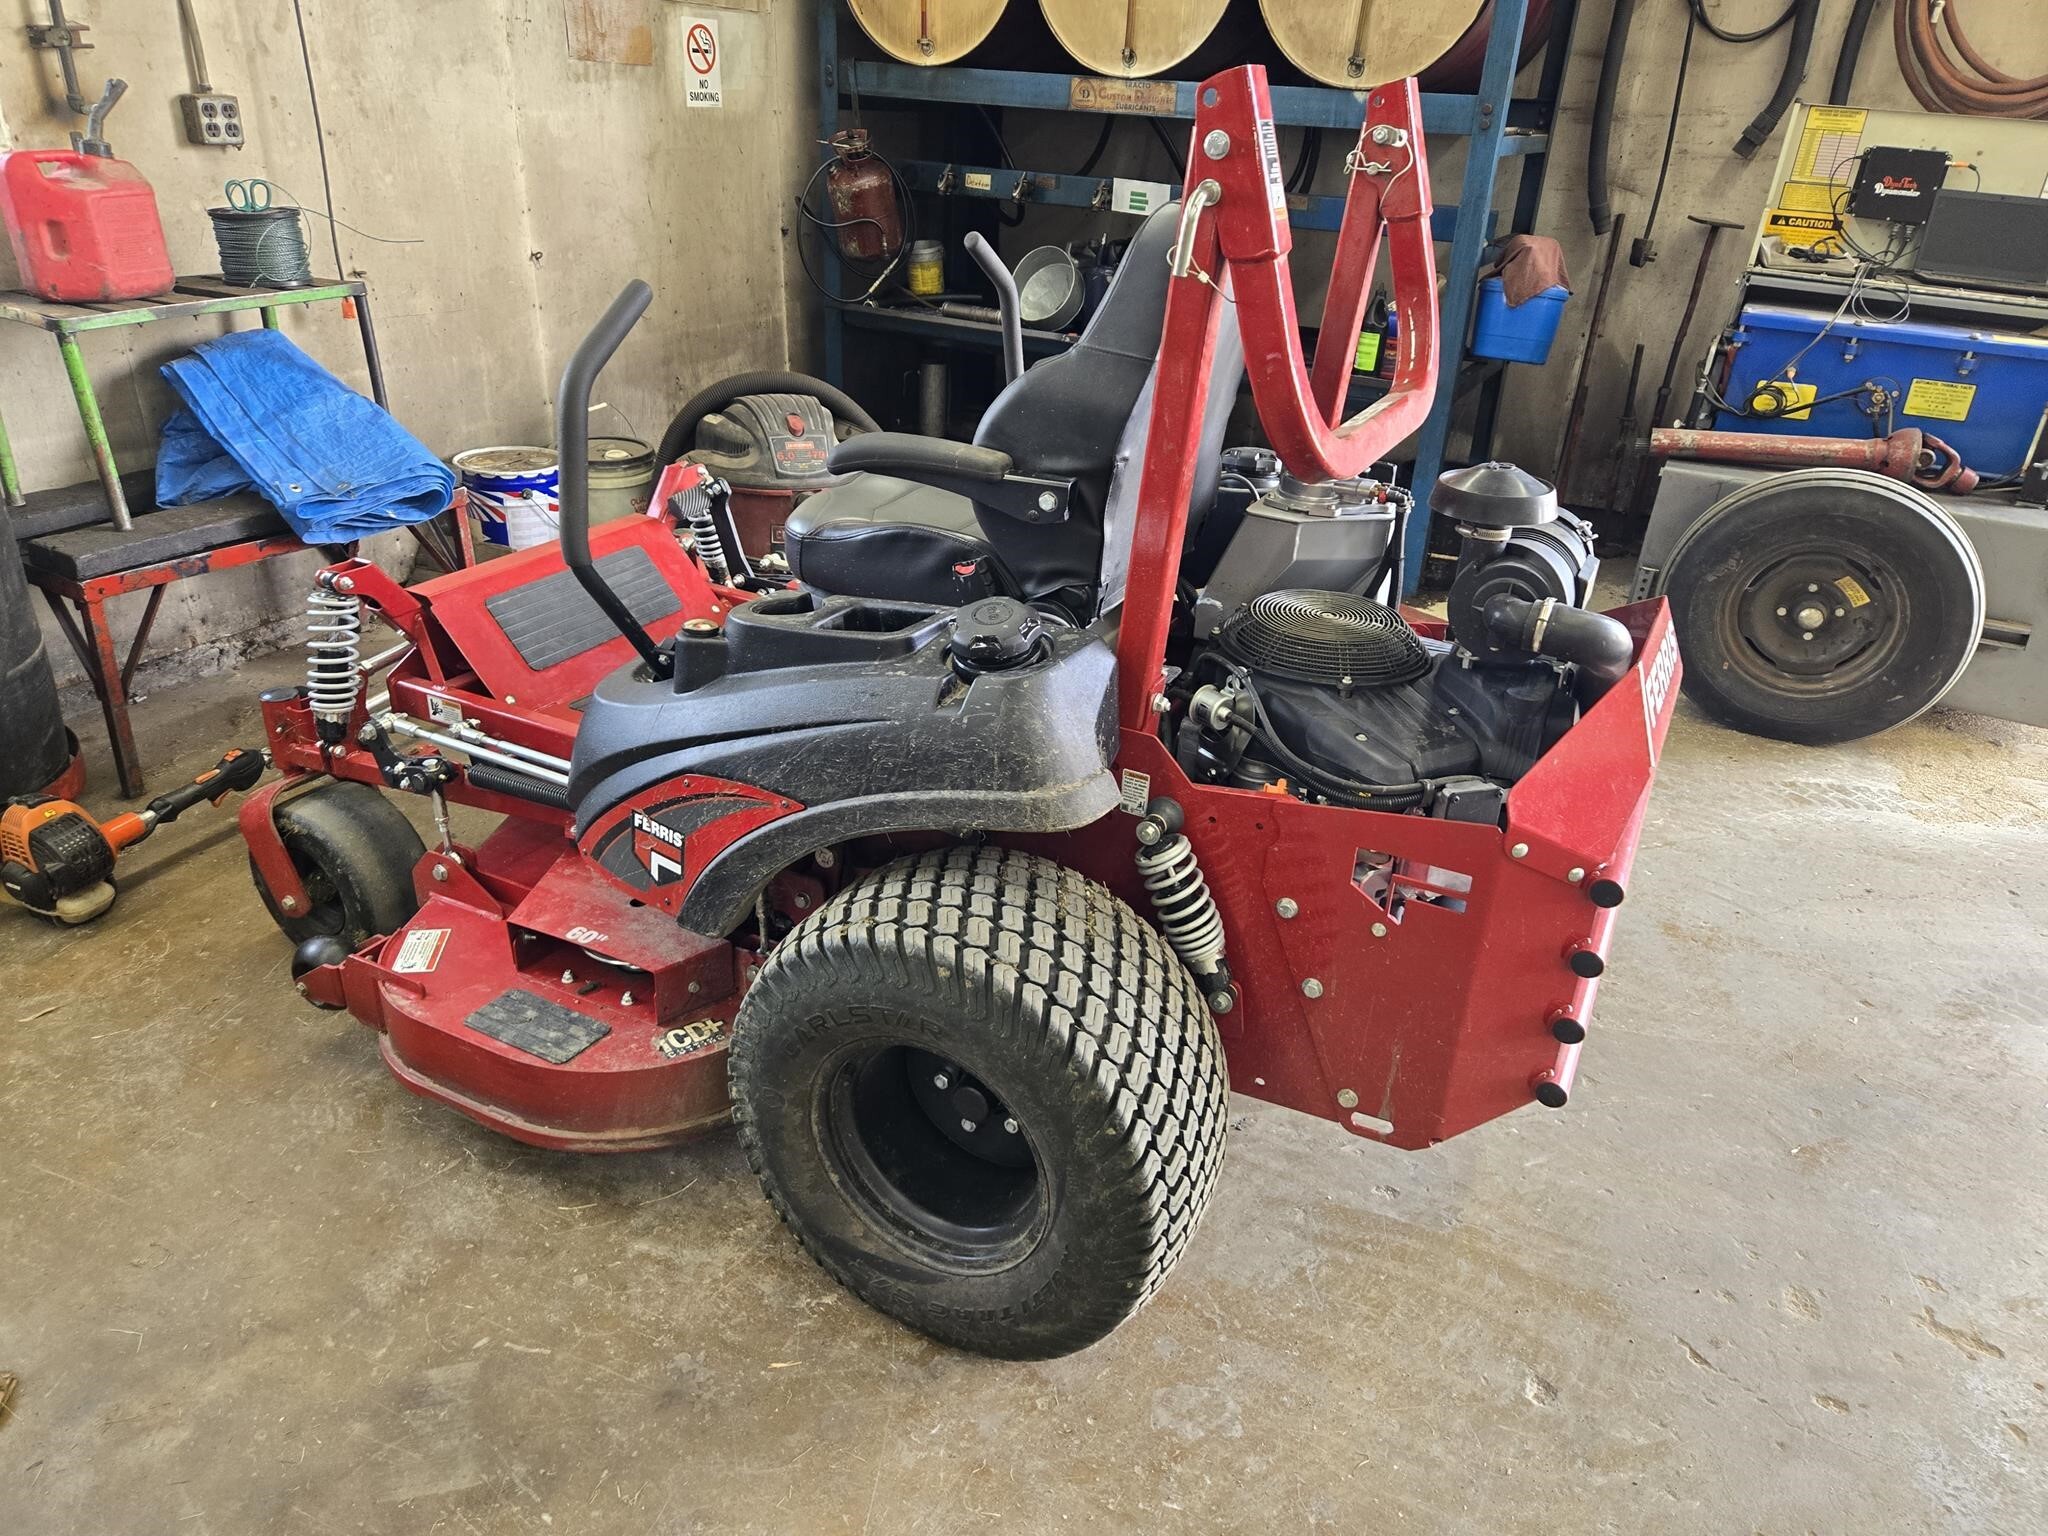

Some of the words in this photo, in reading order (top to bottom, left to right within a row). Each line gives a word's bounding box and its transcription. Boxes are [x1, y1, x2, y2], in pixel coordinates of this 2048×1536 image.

[699, 79, 709, 89] NO
[689, 91, 720, 102] SMOKING
[1116, 103, 1156, 112] LUBRICANTS
[1788, 217, 1834, 229] CAUTION
[1645, 620, 1679, 729] FERRIS
[633, 812, 684, 848] FERRIS
[565, 926, 609, 944] 60"
